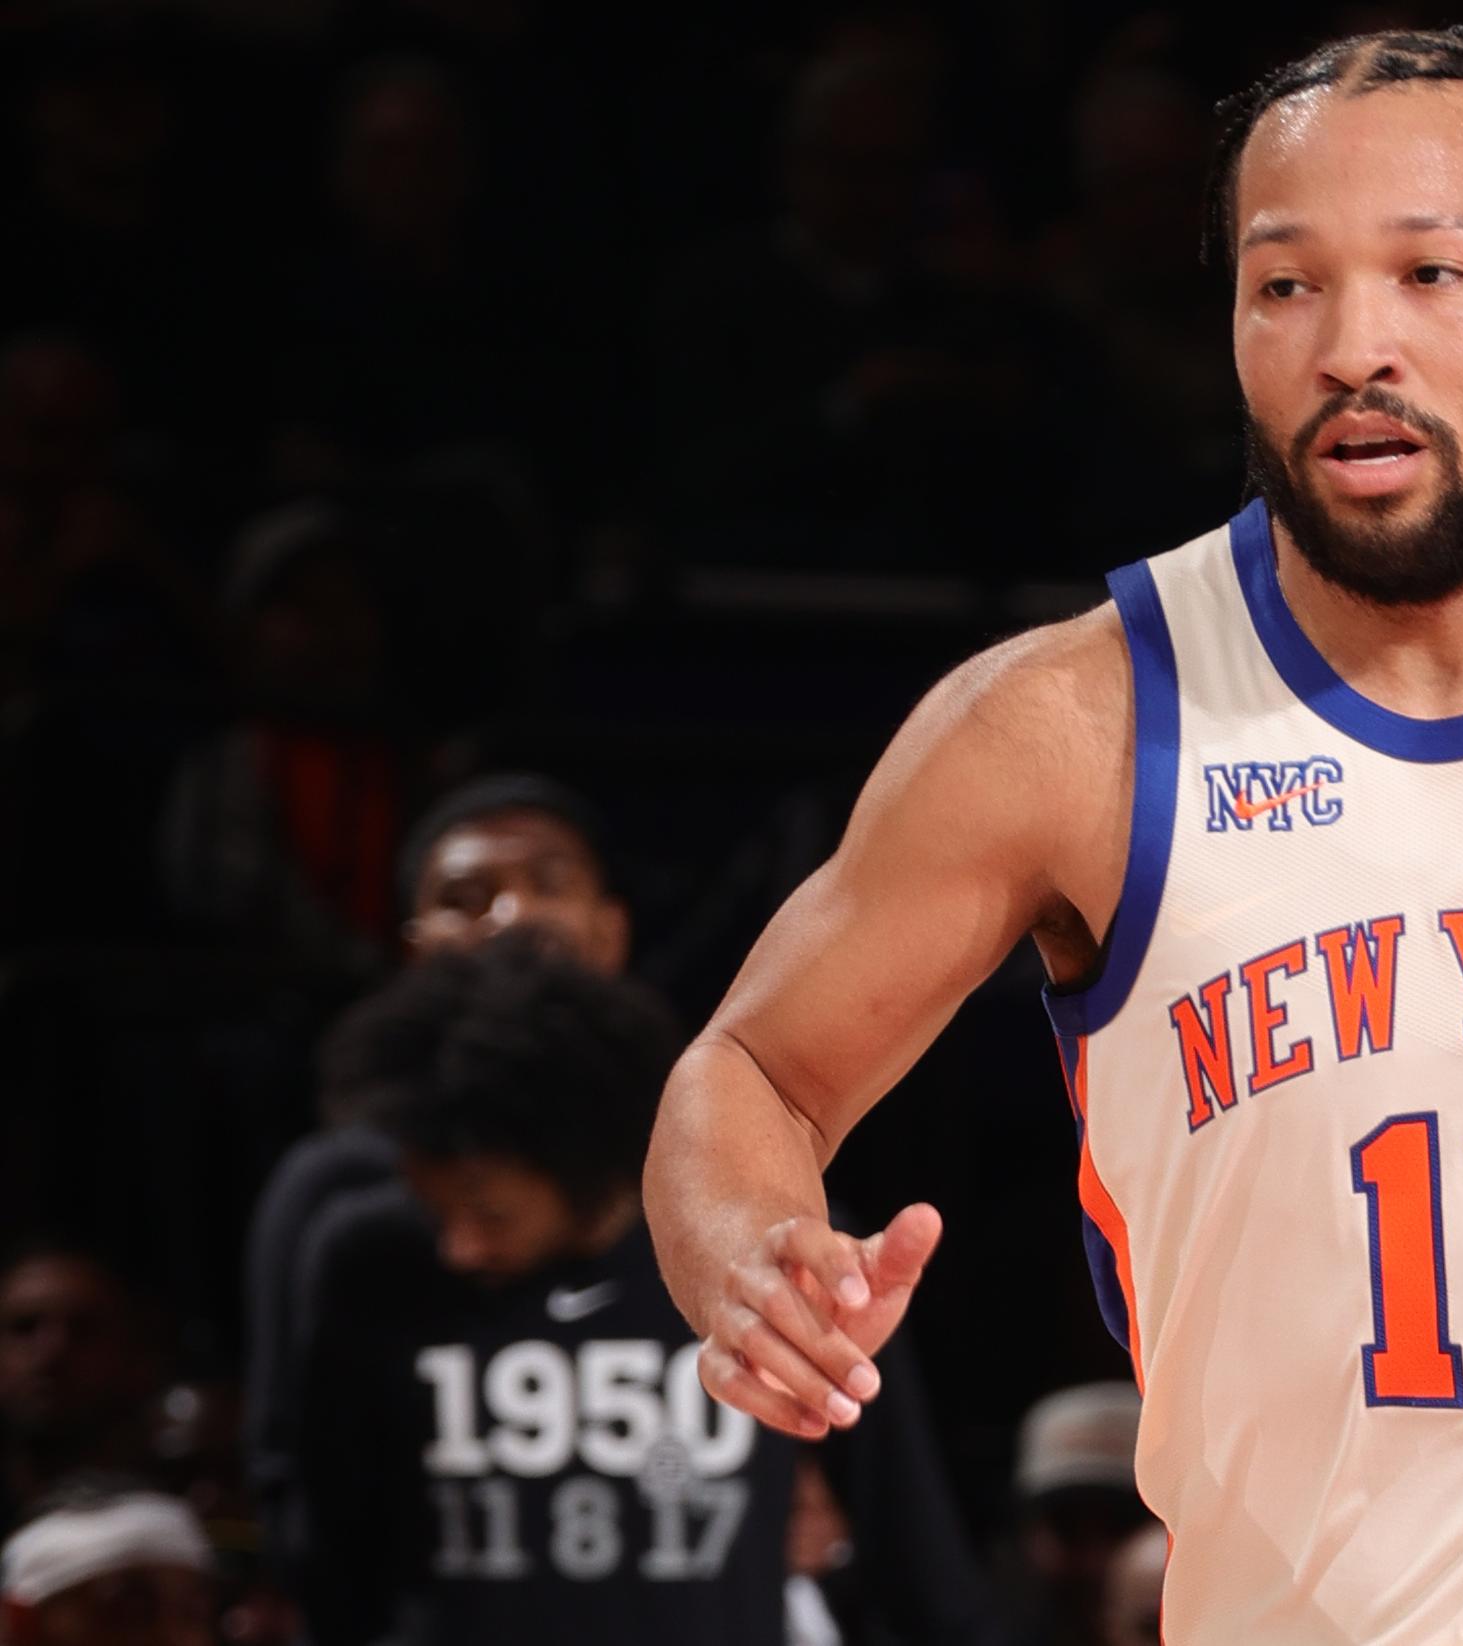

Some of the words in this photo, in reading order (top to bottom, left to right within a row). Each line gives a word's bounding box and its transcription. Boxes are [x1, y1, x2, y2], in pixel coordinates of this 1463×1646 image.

[1203, 755, 1344, 832] NYC
[1169, 913, 1405, 1134] NEW
[415, 1338, 757, 1478] 1950
[549, 1476, 622, 1582] 8
[639, 1478, 750, 1581] 17
